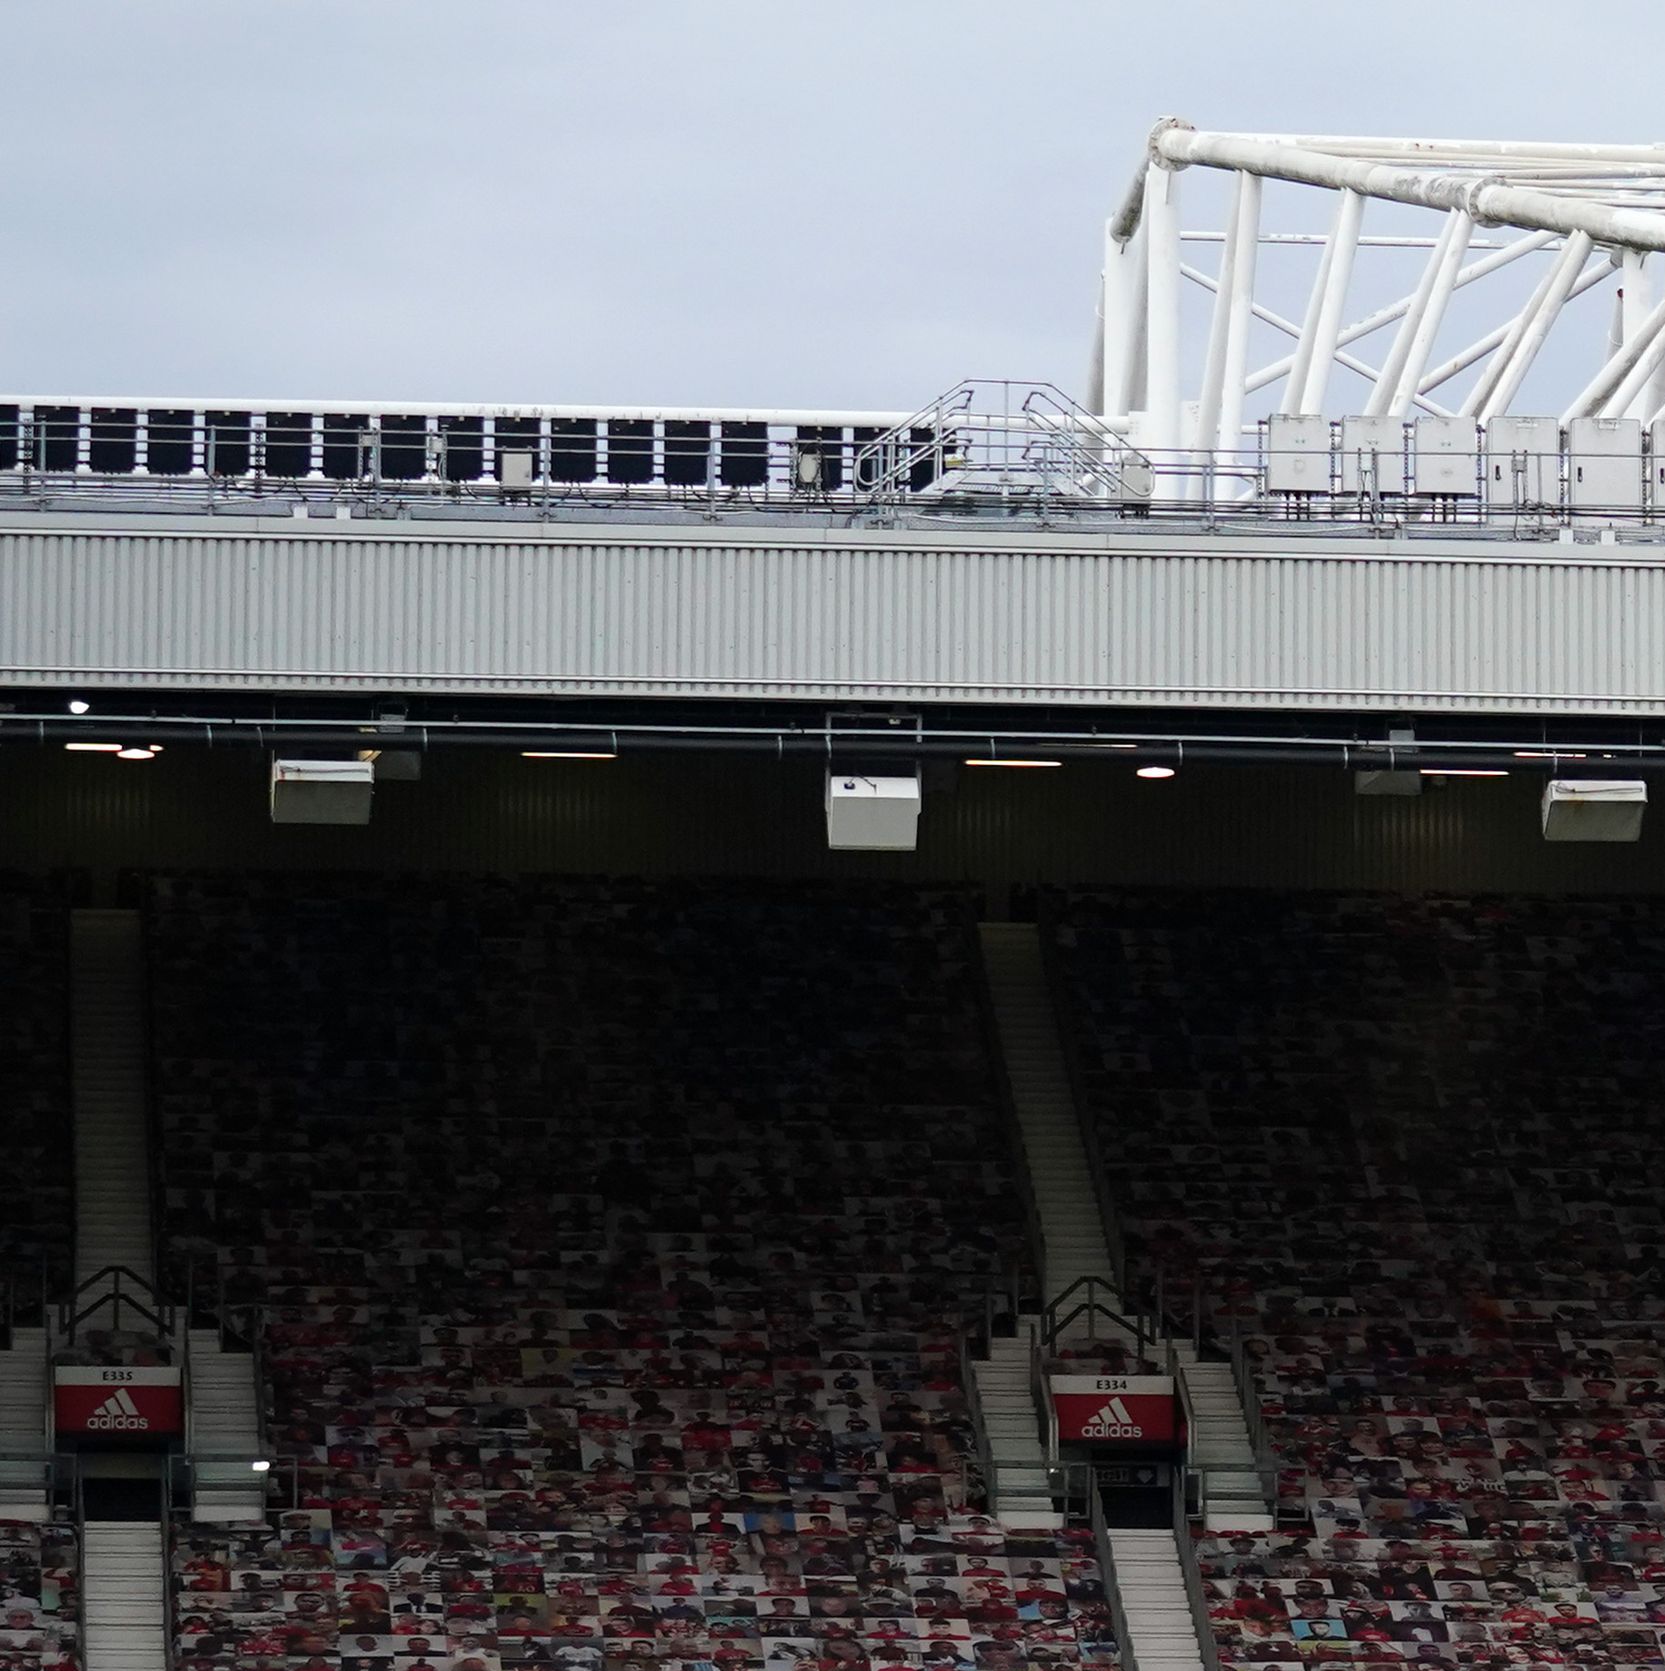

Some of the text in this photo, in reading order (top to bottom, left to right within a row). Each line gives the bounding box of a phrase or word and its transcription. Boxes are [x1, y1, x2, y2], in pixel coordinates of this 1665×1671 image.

[103, 1371, 133, 1380] E335
[1097, 1380, 1127, 1390] E334
[87, 1414, 148, 1429] adidas
[1081, 1423, 1142, 1438] adidas
